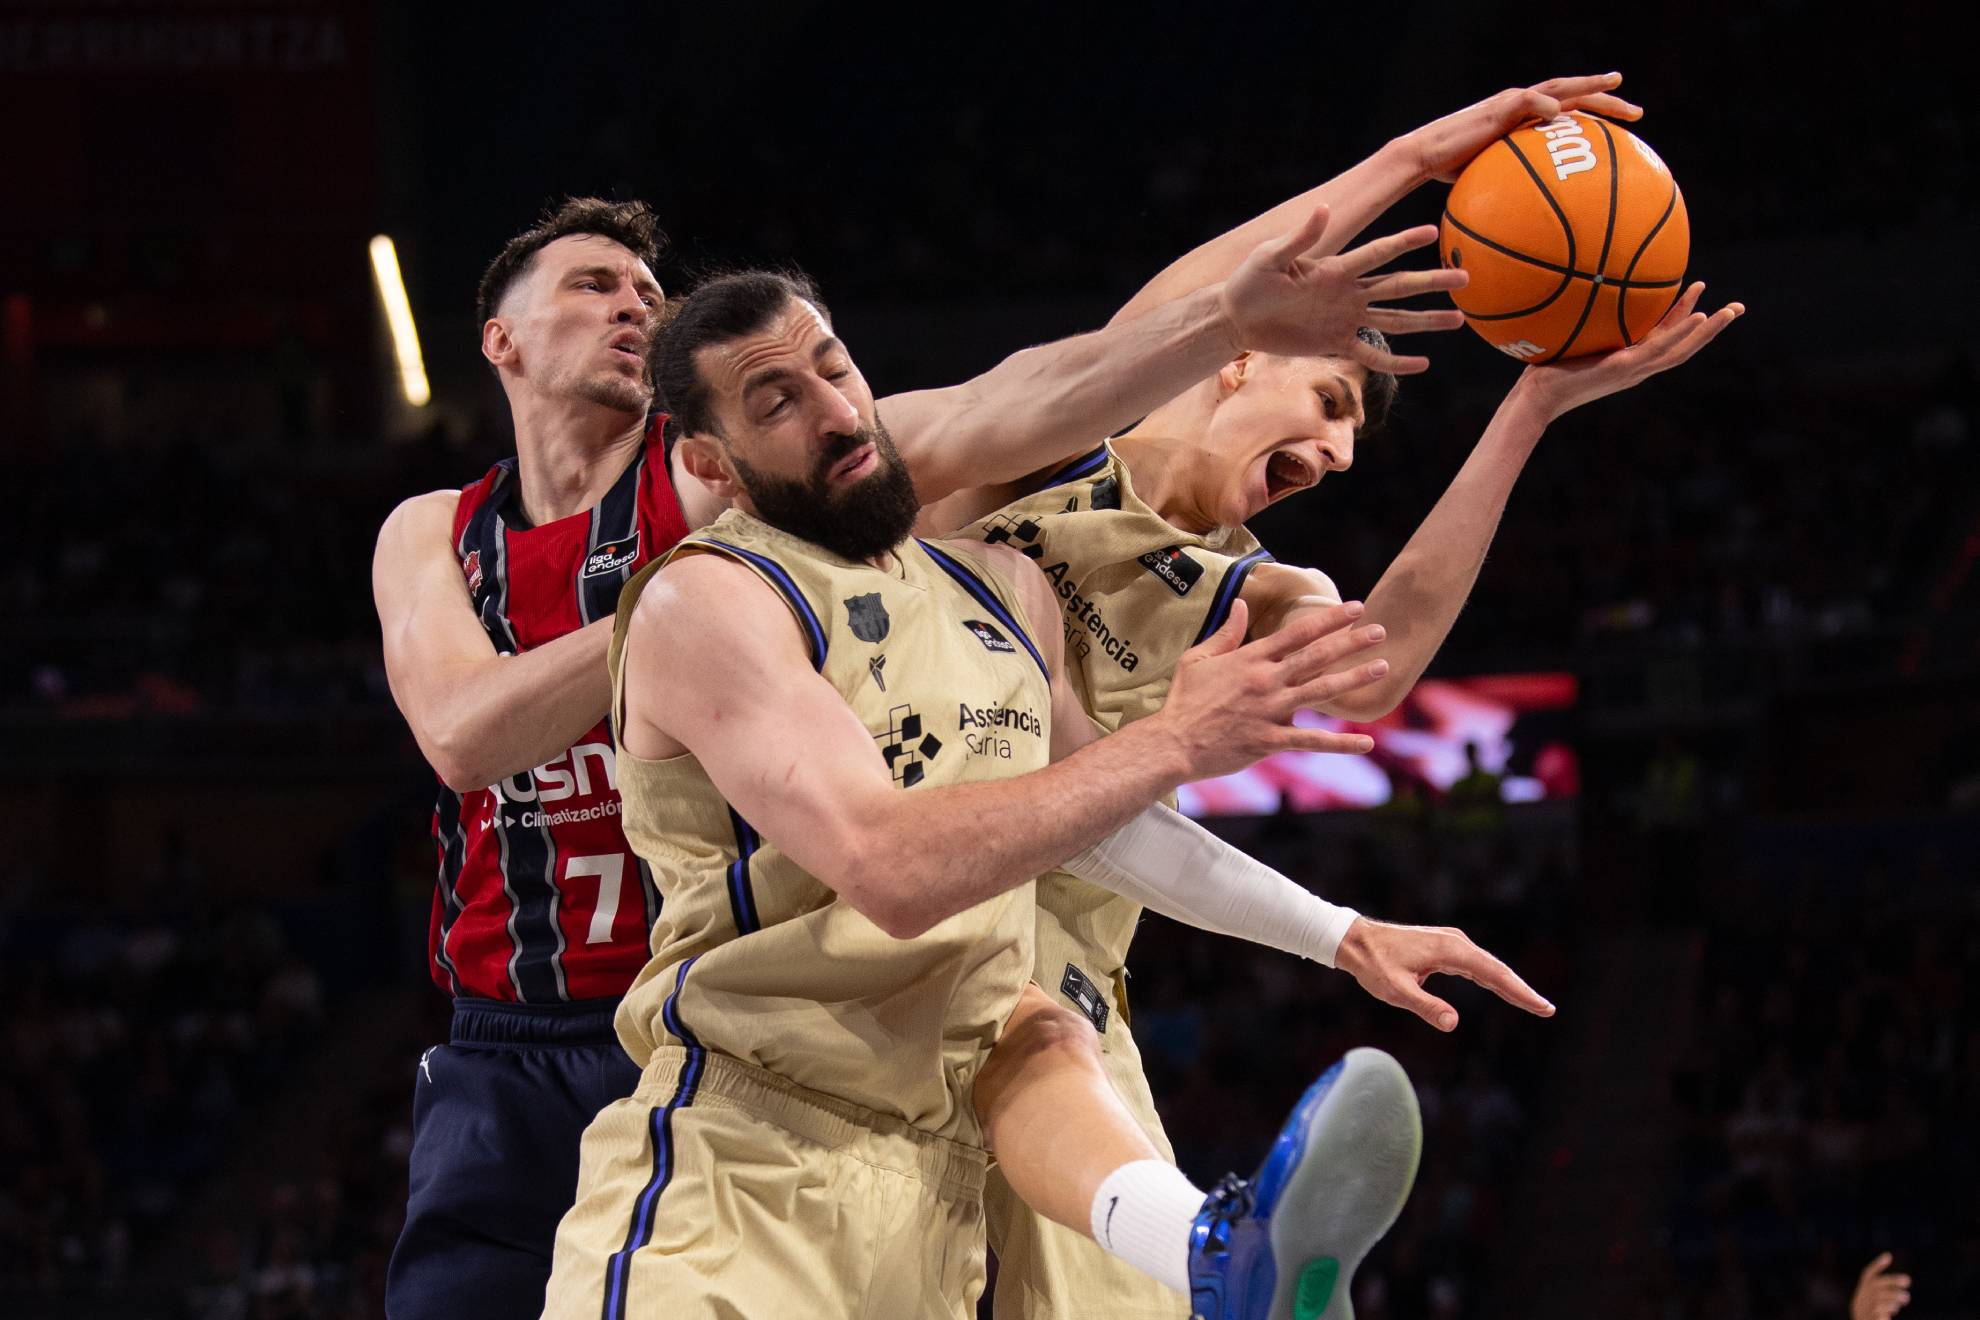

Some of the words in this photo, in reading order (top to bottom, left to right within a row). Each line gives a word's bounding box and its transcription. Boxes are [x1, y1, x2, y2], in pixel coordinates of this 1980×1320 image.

[588, 550, 636, 573] endesa
[590, 553, 613, 565] liga
[1144, 554, 1189, 592] endesa
[564, 852, 625, 945] 7
